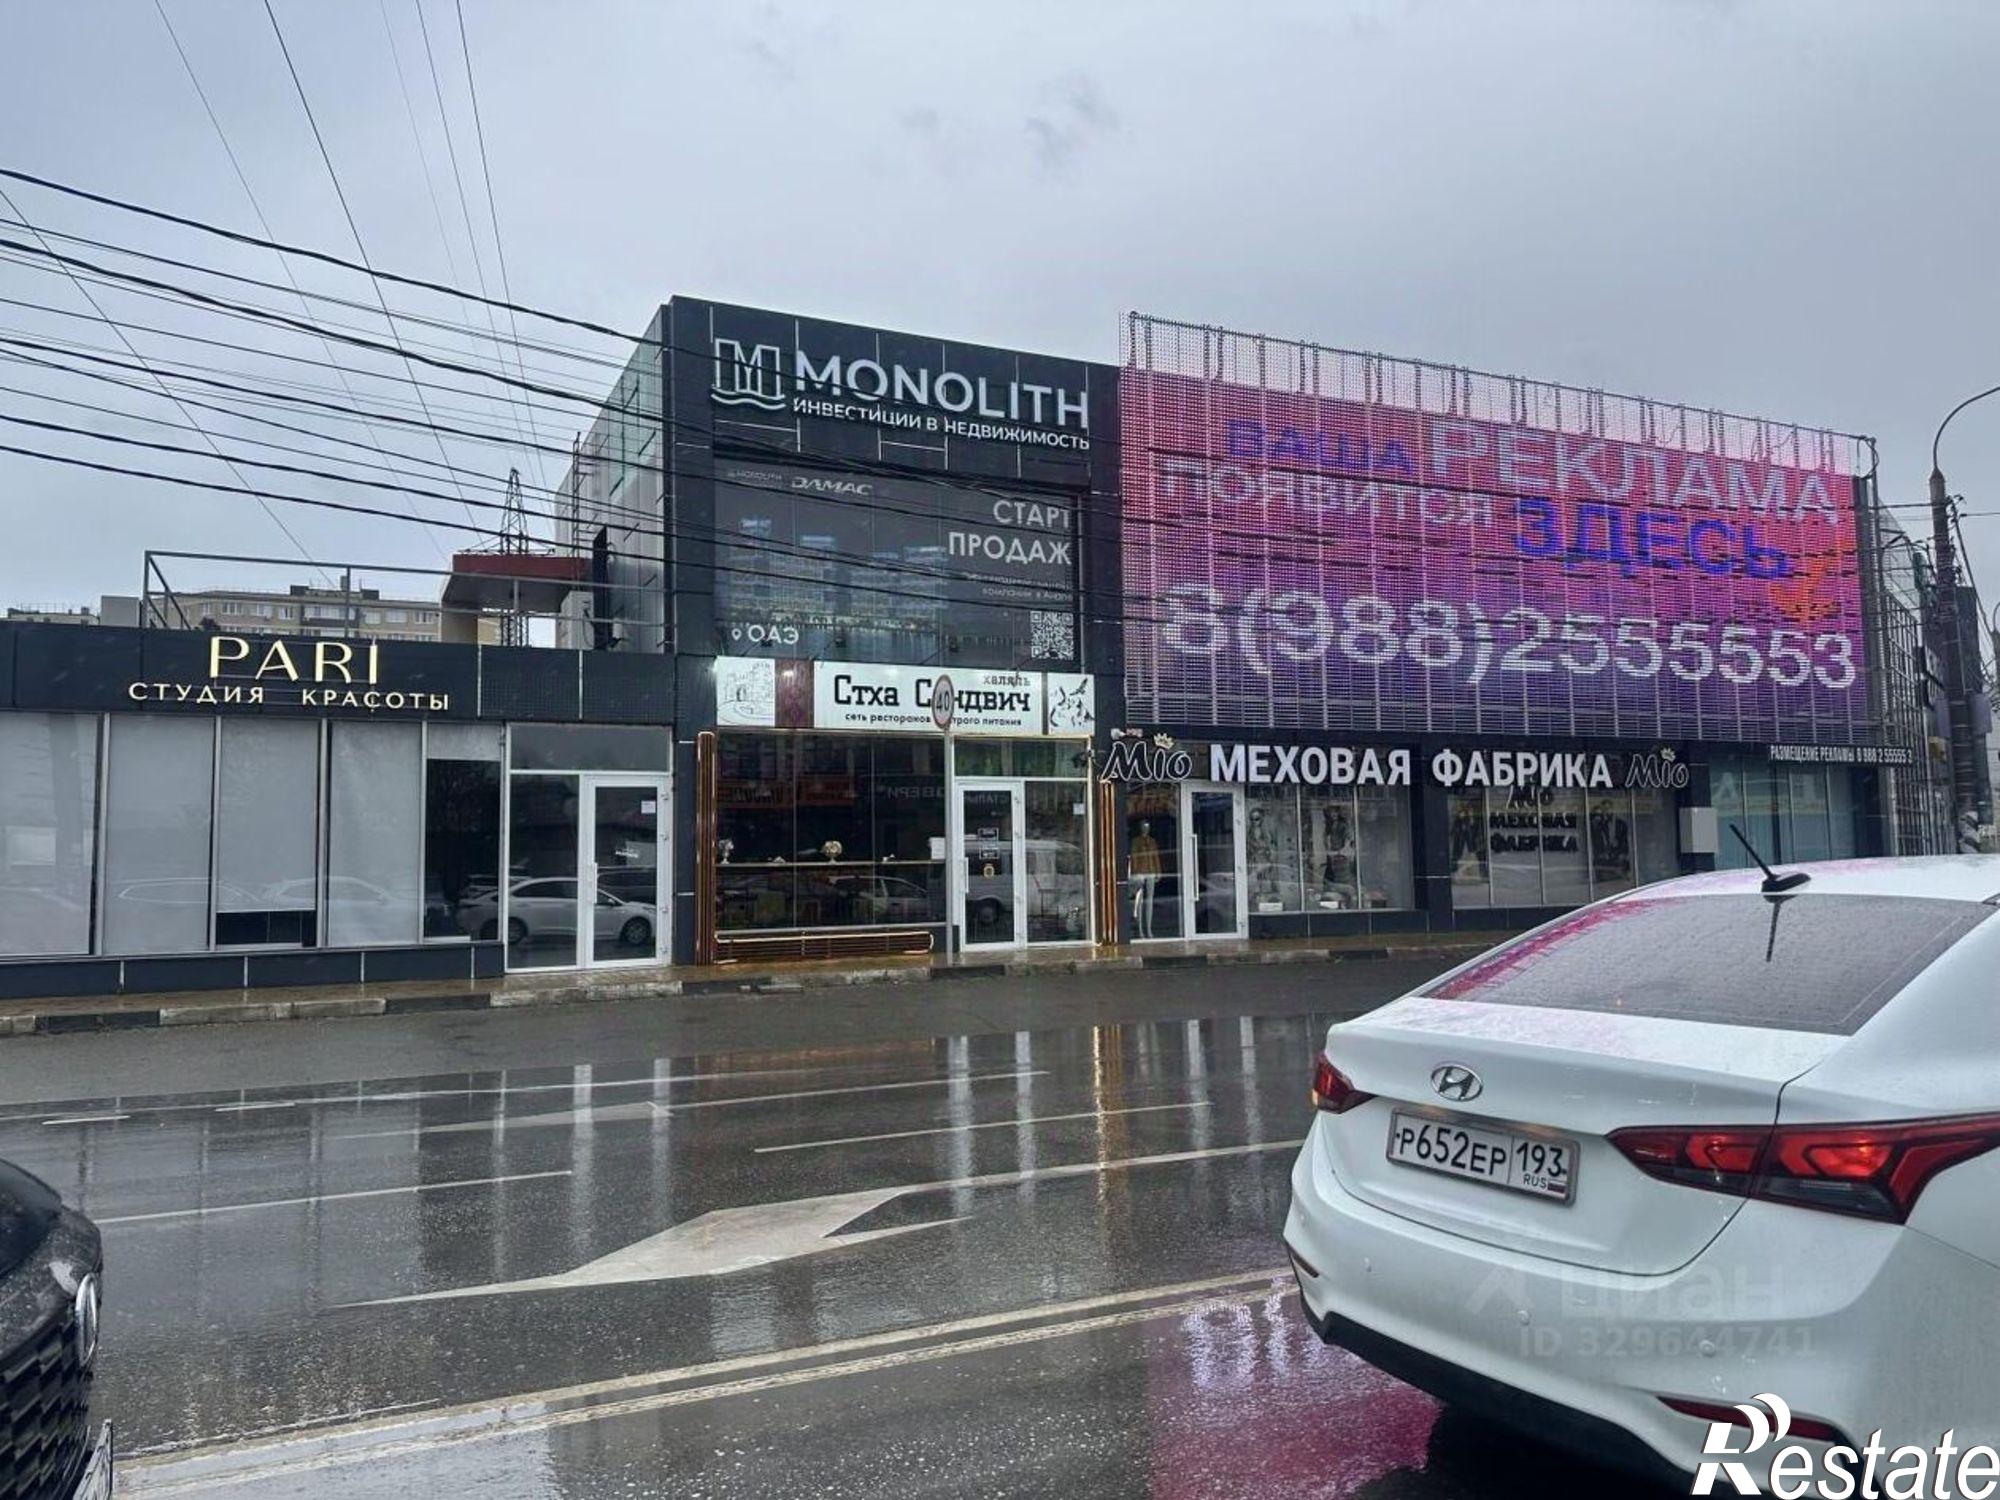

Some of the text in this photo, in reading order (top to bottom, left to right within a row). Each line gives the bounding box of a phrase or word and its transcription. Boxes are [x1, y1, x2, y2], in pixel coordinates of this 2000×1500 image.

[795, 350, 1090, 428] MONOLITH
[793, 396, 1090, 450] ИНВЕСТИЦИИ В НЕДВИЖИМОСТЬ
[1226, 418, 1839, 524] ВАША РЕКЛАМА
[992, 499, 1072, 529] СТАРТ
[948, 531, 1072, 565] ПРОДАЖ
[1514, 496, 1793, 579] ЗДЕСЬ
[747, 624, 799, 645] ОАЭ
[210, 636, 378, 685] PARI
[128, 681, 448, 710] СТУДИЯ КРАСОТЫ
[914, 677, 1031, 712] Сндвич
[935, 690, 950, 711] 40
[845, 713, 867, 722] сеть
[870, 714, 932, 725] ресторанов
[981, 718, 1022, 726] питания
[1210, 743, 1613, 788] МЕХОВАЯ ФАБРИКА
[1399, 1124, 1563, 1177] Р652ЕР 193
[1522, 1173, 1547, 1189] RUS
